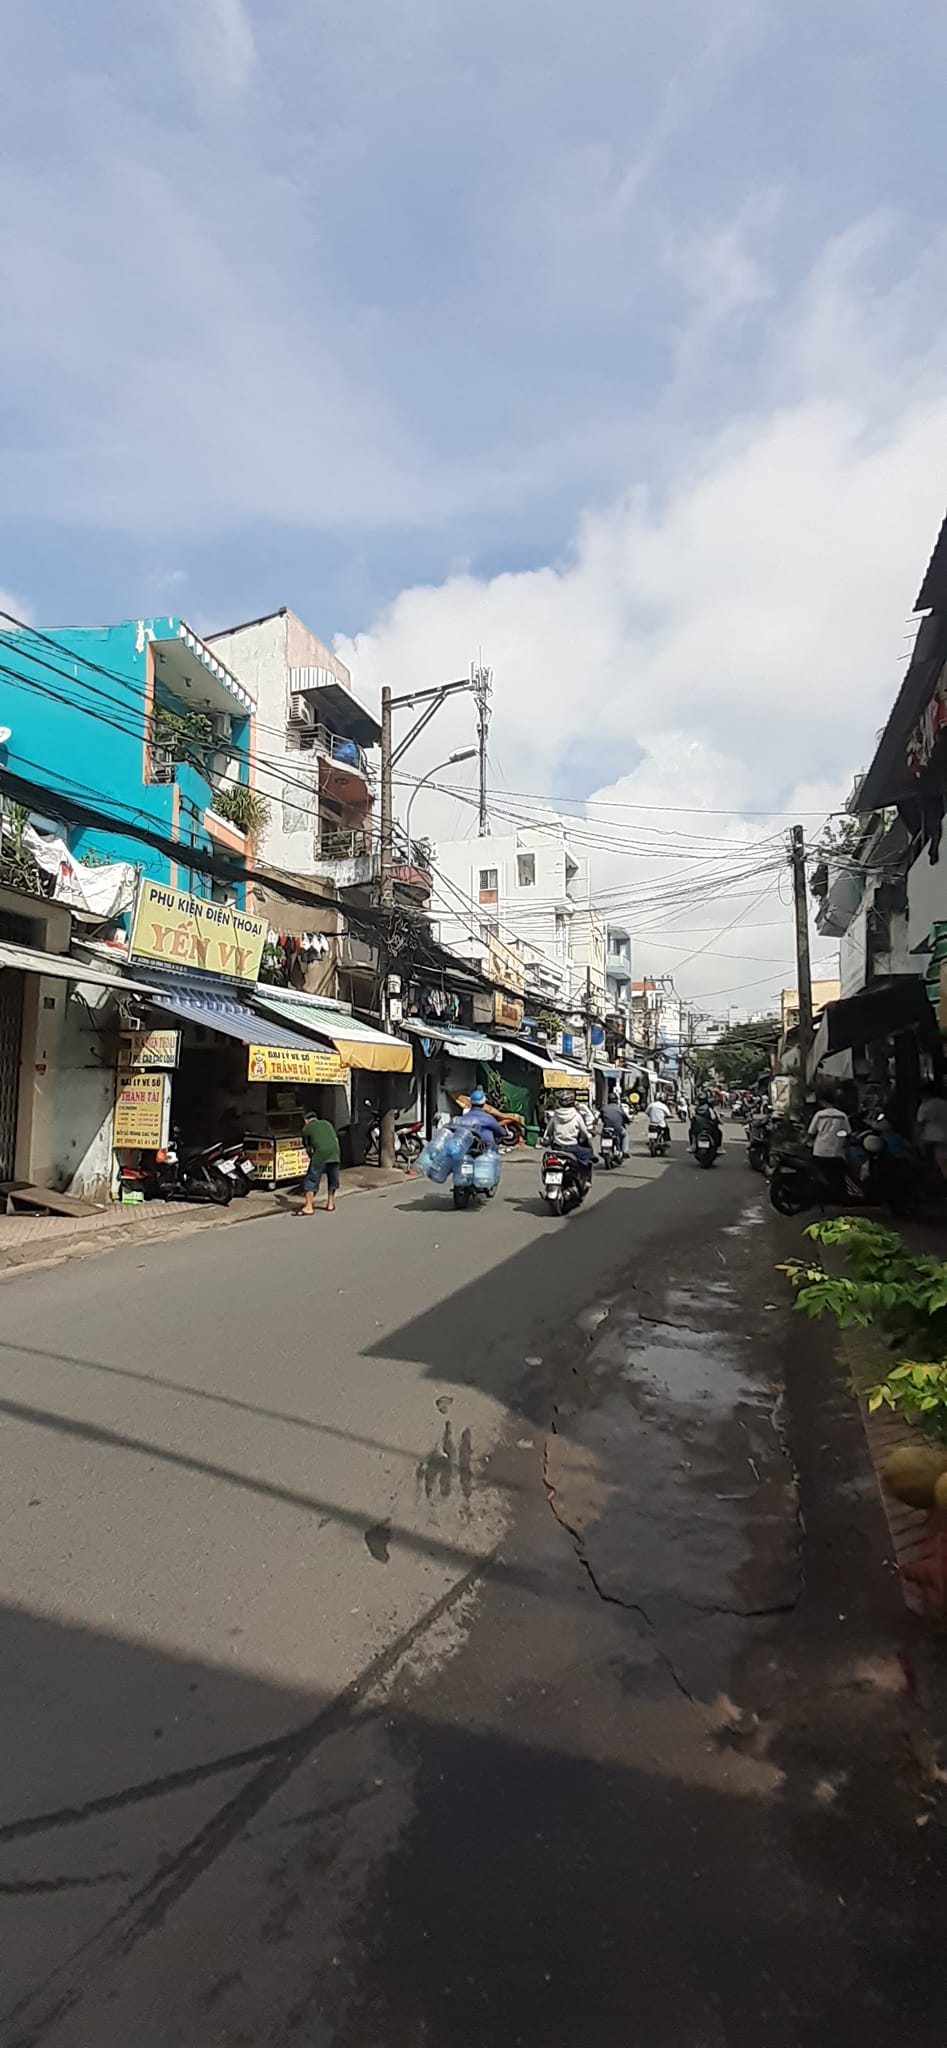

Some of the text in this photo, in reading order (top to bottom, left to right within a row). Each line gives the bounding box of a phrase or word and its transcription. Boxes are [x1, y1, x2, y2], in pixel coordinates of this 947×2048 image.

[149, 888, 262, 937] PHỤ KIỆN ĐIỆN THOẠI
[151, 921, 211, 963] YẾN
[218, 942, 253, 971] VY
[271, 1060, 298, 1075] THÀNH
[121, 1088, 146, 1102] THÀNH
